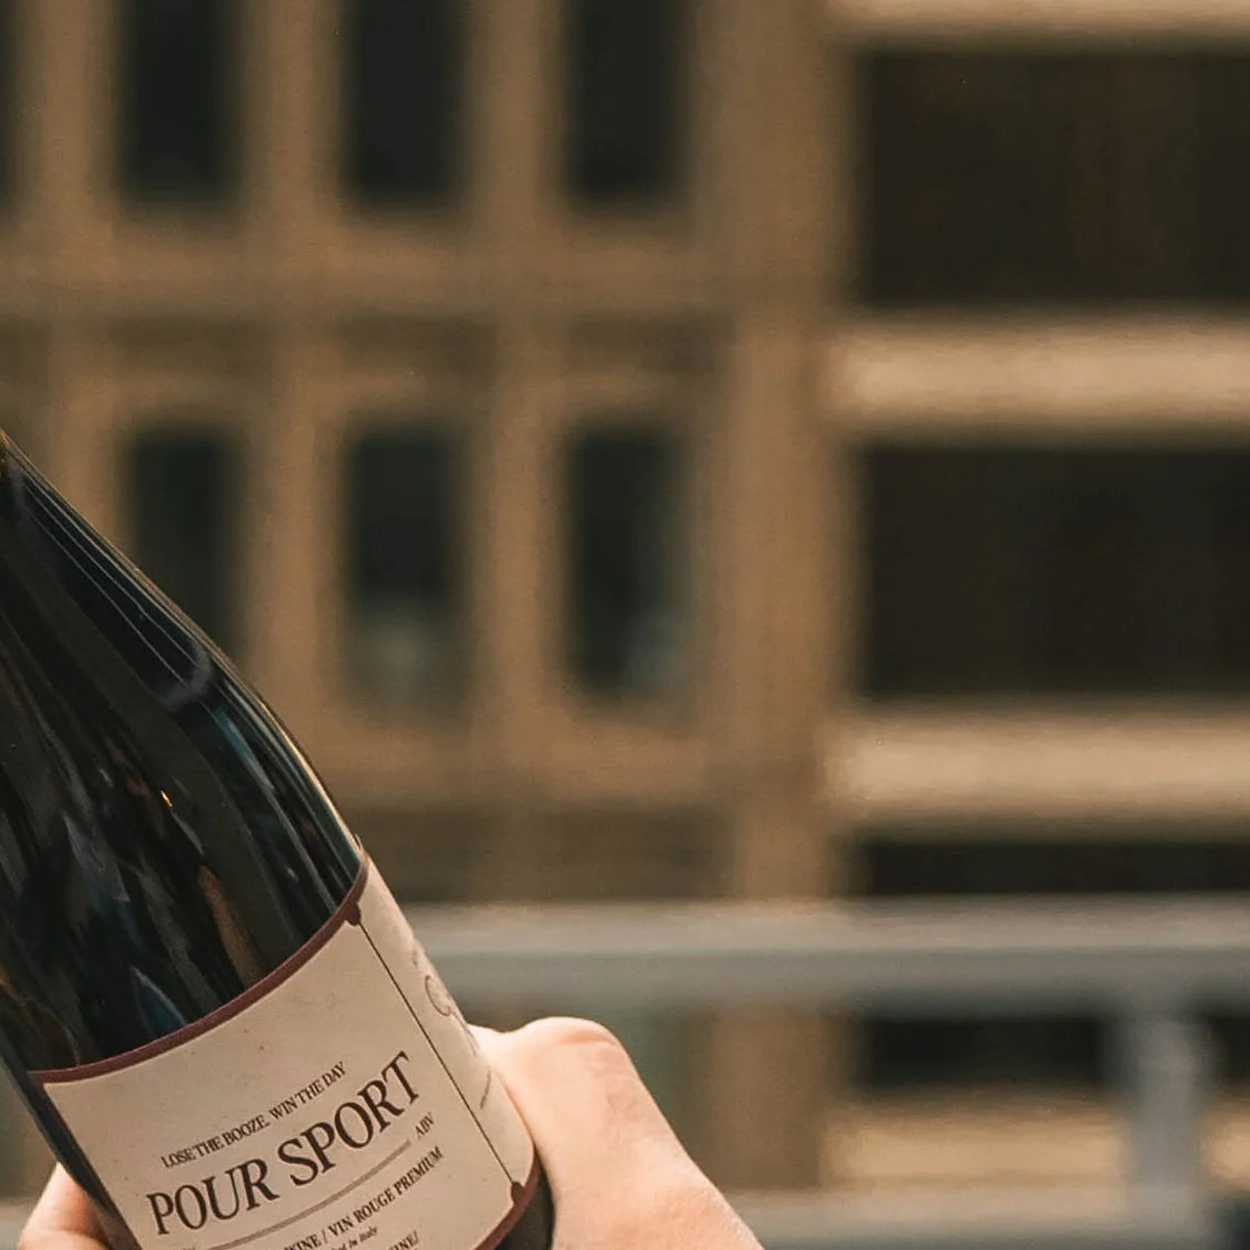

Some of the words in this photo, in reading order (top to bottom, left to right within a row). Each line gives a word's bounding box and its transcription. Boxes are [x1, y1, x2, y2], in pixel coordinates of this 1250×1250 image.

[146, 1158, 281, 1236] POUR
[277, 1050, 420, 1187] SPORT
[160, 1147, 197, 1169] LOSE
[191, 1136, 225, 1157] THE
[268, 1096, 298, 1120] WIN
[294, 1079, 325, 1105] THE
[321, 1061, 346, 1088] DAY
[414, 1111, 436, 1140] ABV
[320, 1227, 329, 1245] /
[327, 1215, 354, 1237] VIN
[352, 1187, 396, 1224] ROUGE
[393, 1145, 443, 1196] PREMIUM
